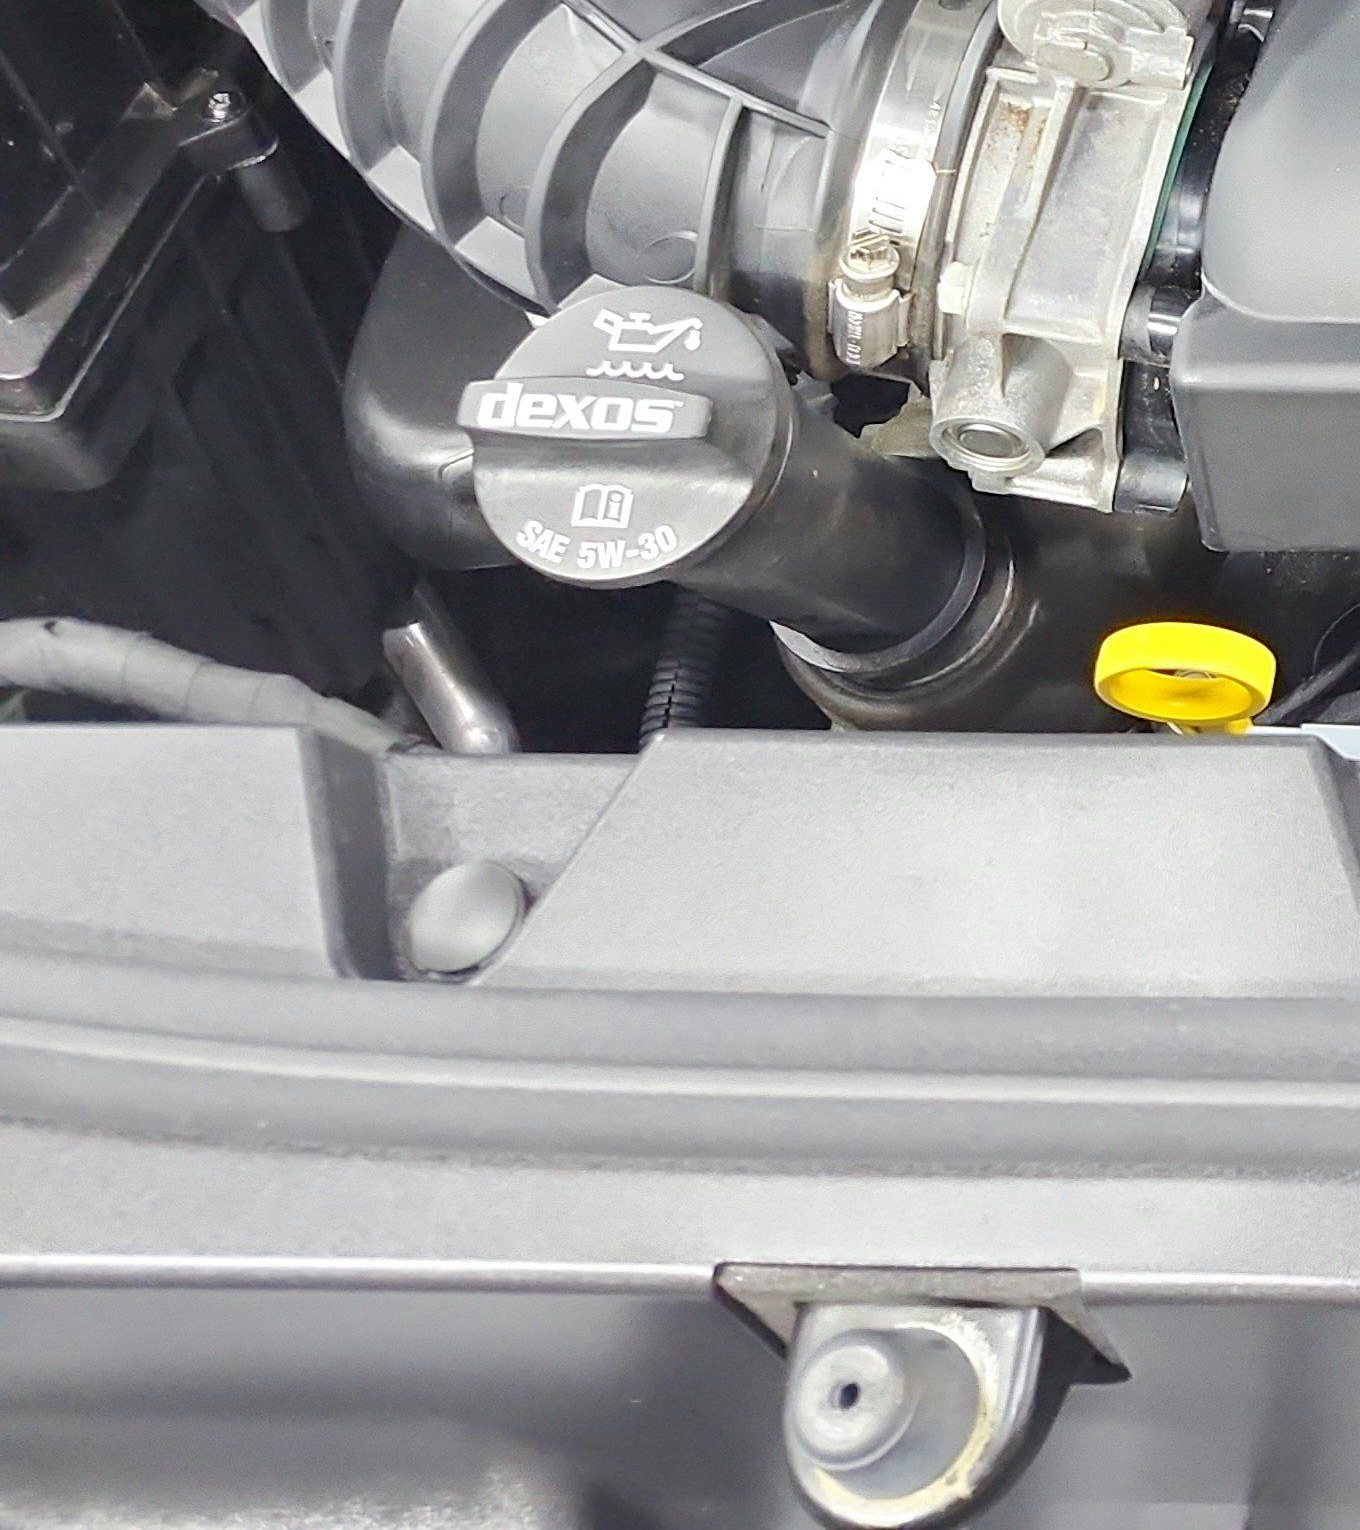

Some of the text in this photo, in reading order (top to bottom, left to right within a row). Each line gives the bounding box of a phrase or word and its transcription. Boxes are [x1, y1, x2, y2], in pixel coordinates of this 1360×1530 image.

[478, 384, 675, 432] dexos
[517, 521, 677, 569] SAE 5W-30
